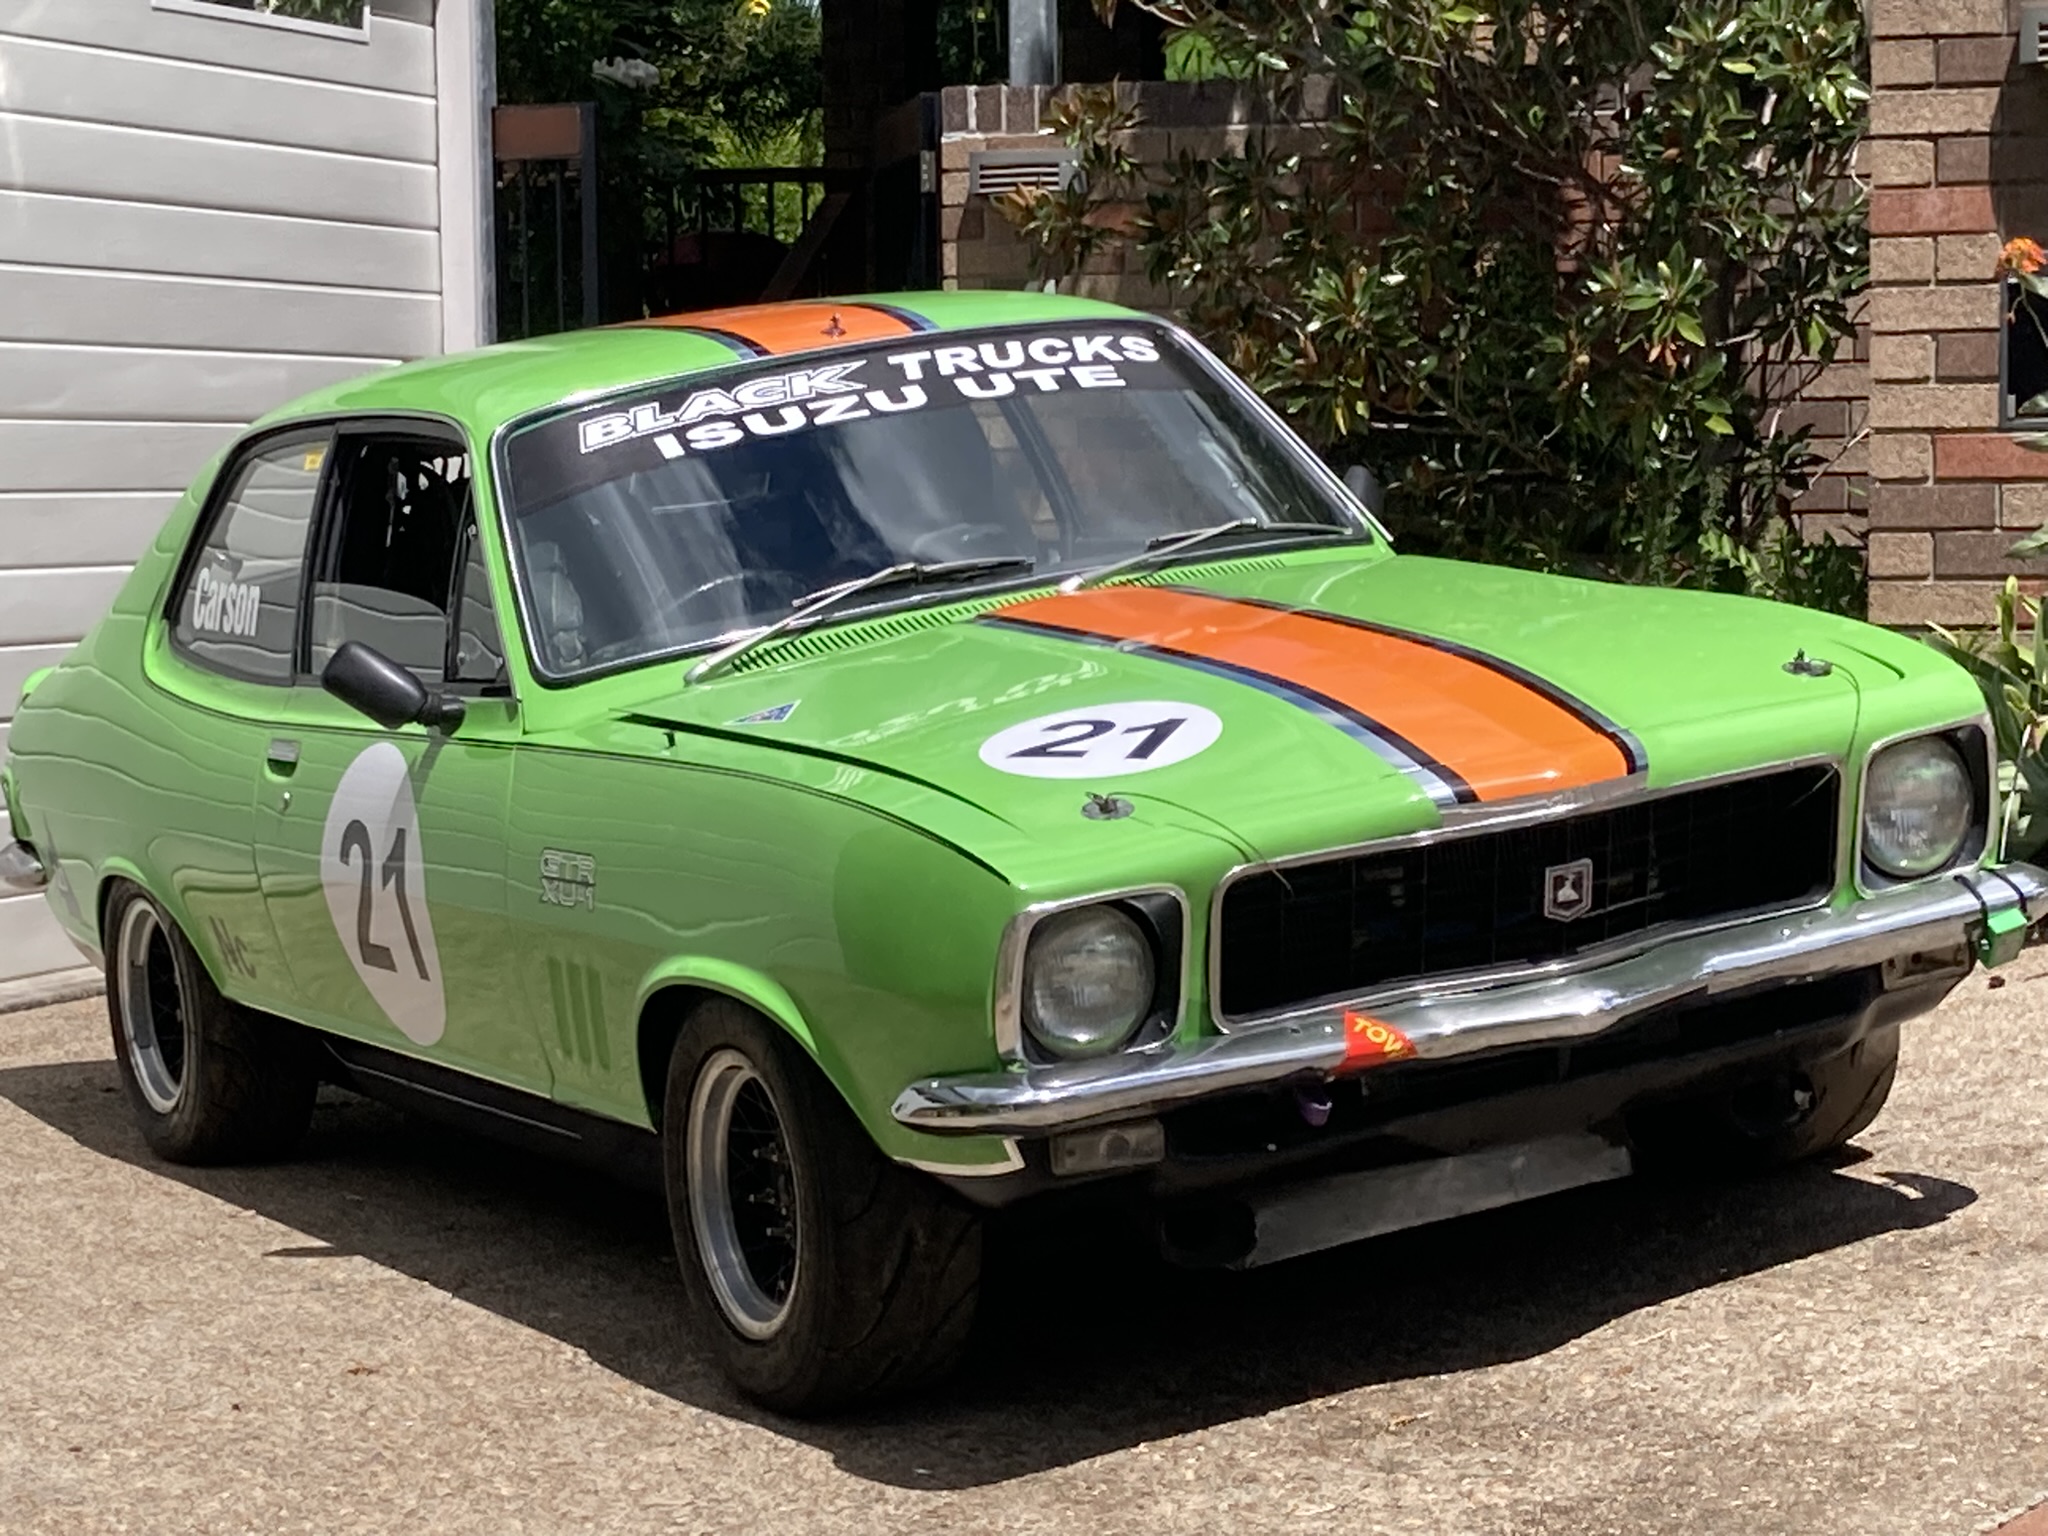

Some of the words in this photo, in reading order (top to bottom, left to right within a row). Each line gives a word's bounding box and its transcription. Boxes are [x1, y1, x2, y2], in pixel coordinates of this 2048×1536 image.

[579, 360, 868, 454] BLACK
[887, 335, 1160, 380] TRUCKS
[653, 384, 928, 460] ISUZU
[953, 365, 1126, 398] UTE
[193, 568, 260, 637] Carson
[1006, 718, 1187, 760] 21
[340, 819, 430, 981] 21
